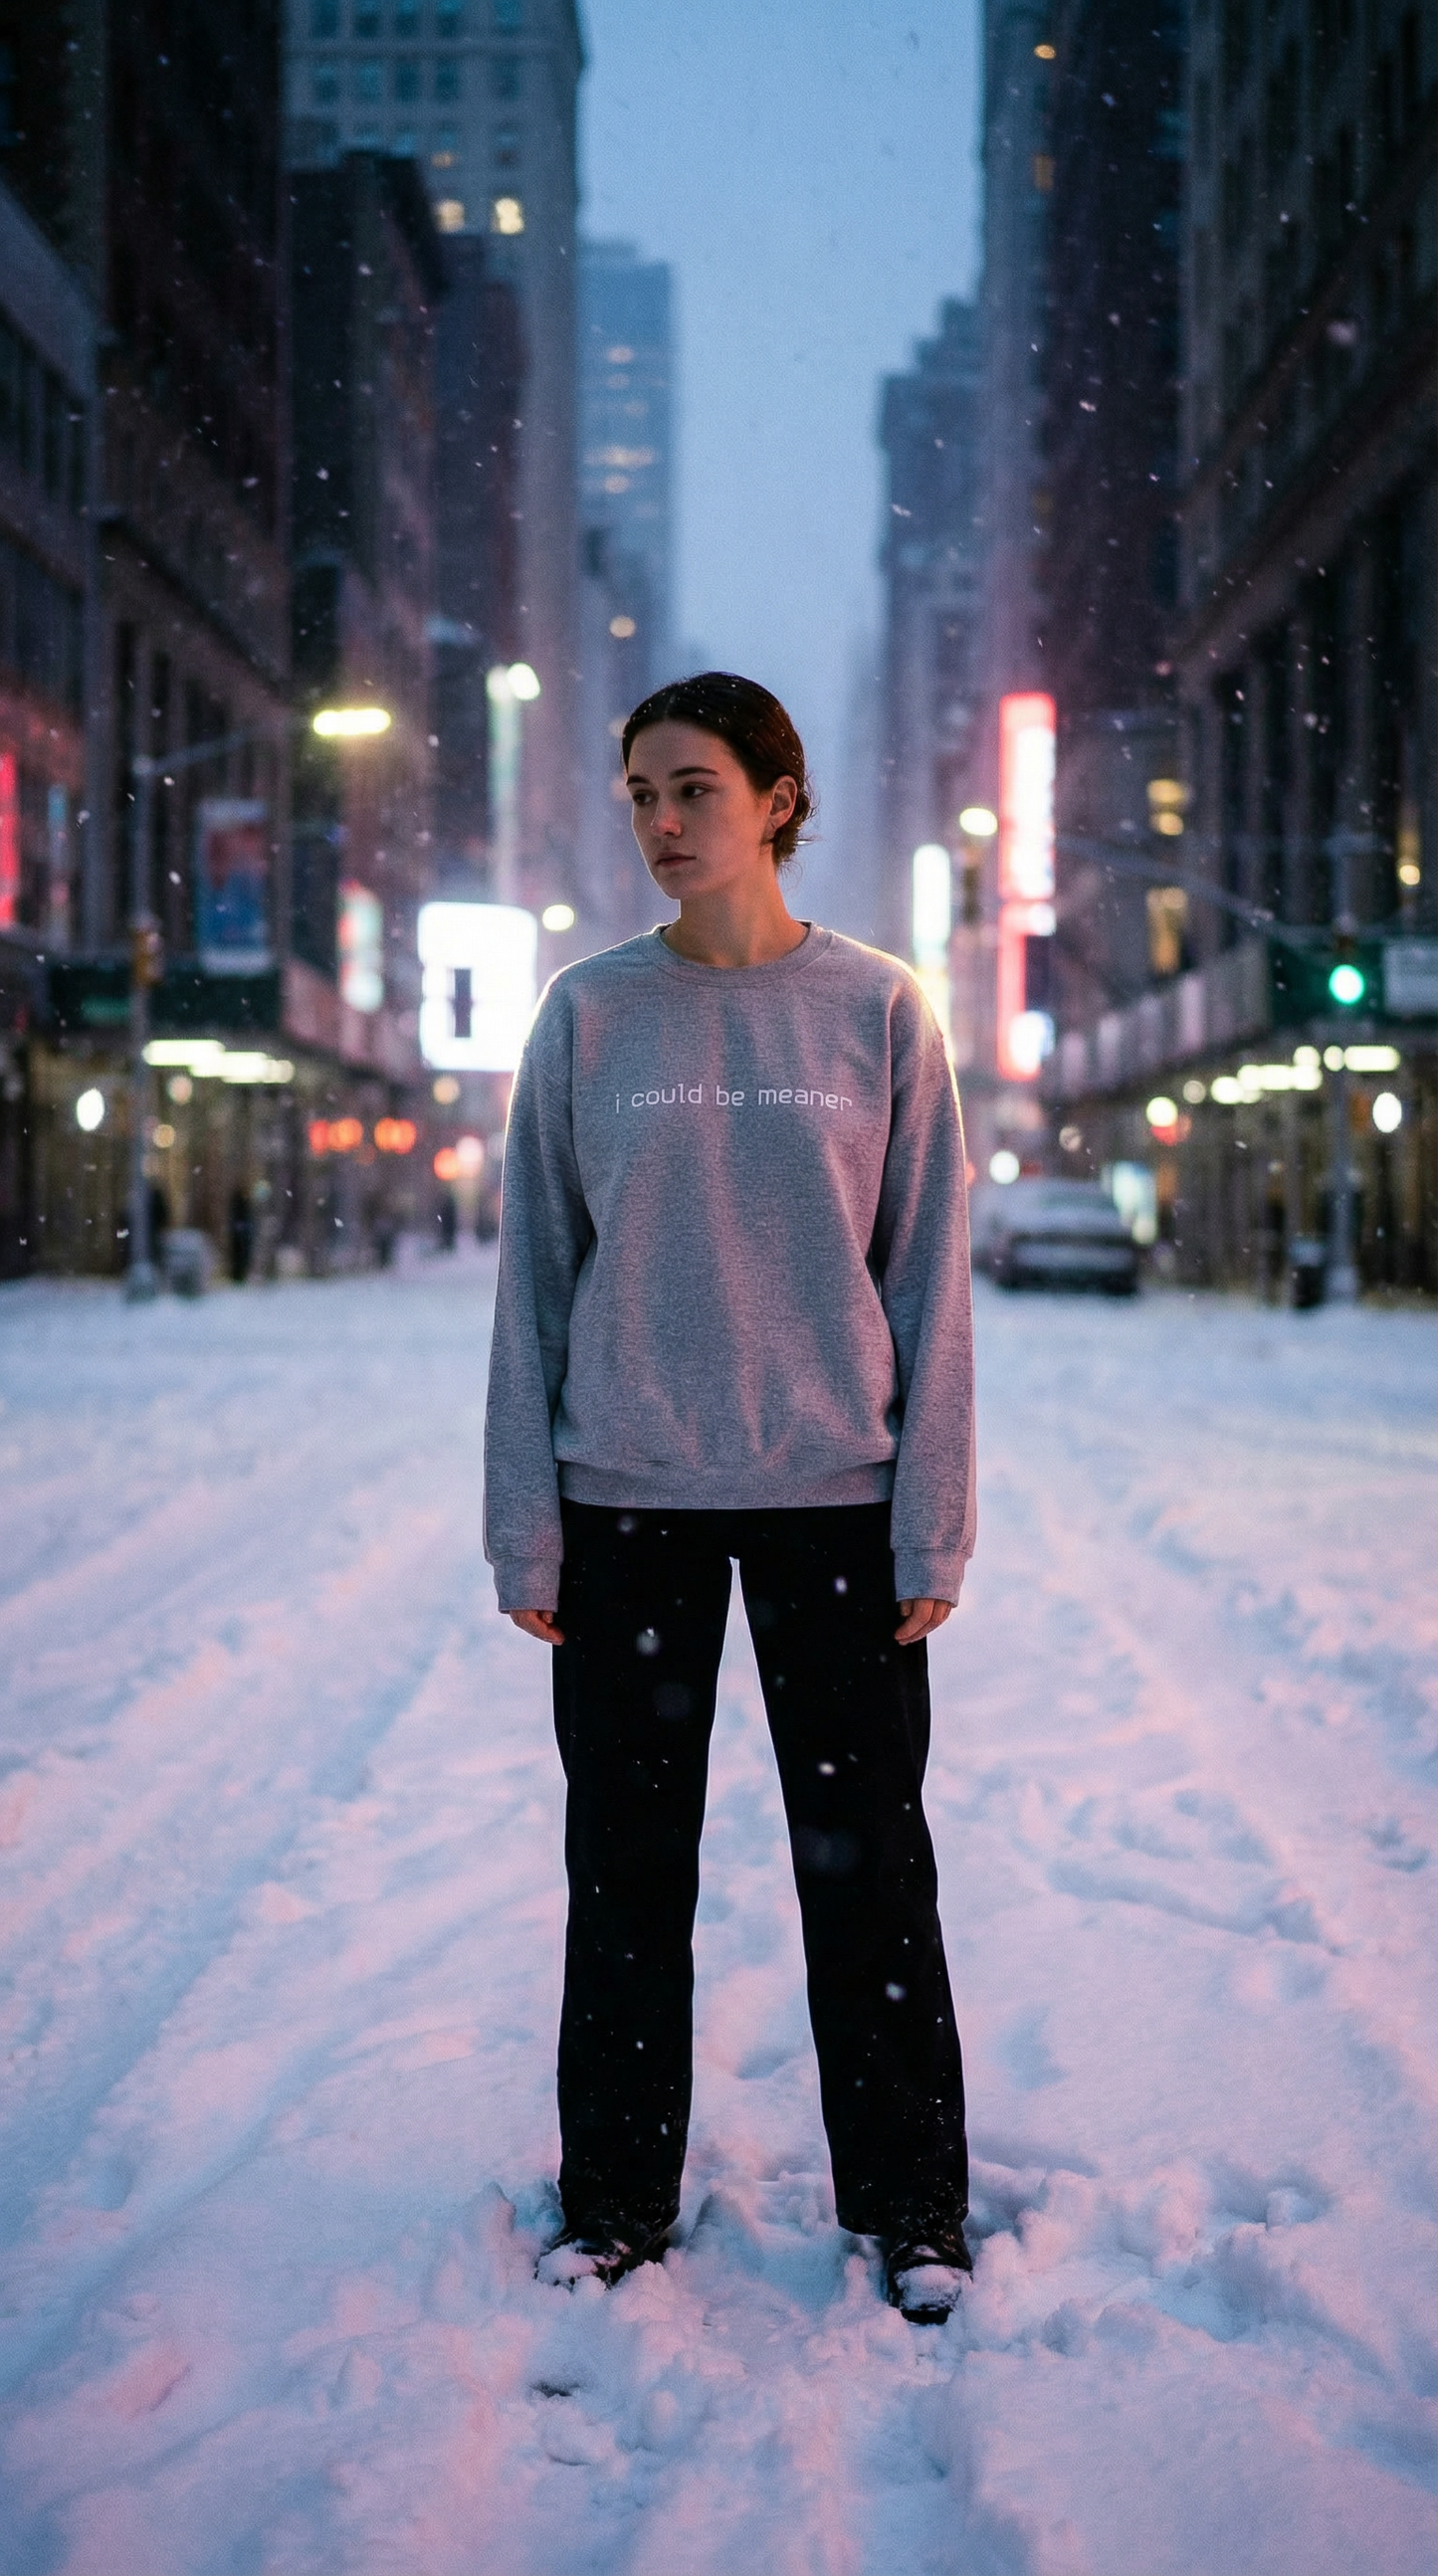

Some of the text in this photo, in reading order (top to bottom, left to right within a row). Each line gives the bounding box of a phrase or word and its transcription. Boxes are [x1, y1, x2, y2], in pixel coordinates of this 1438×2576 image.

[615, 1084, 853, 1113] i could be meaner
